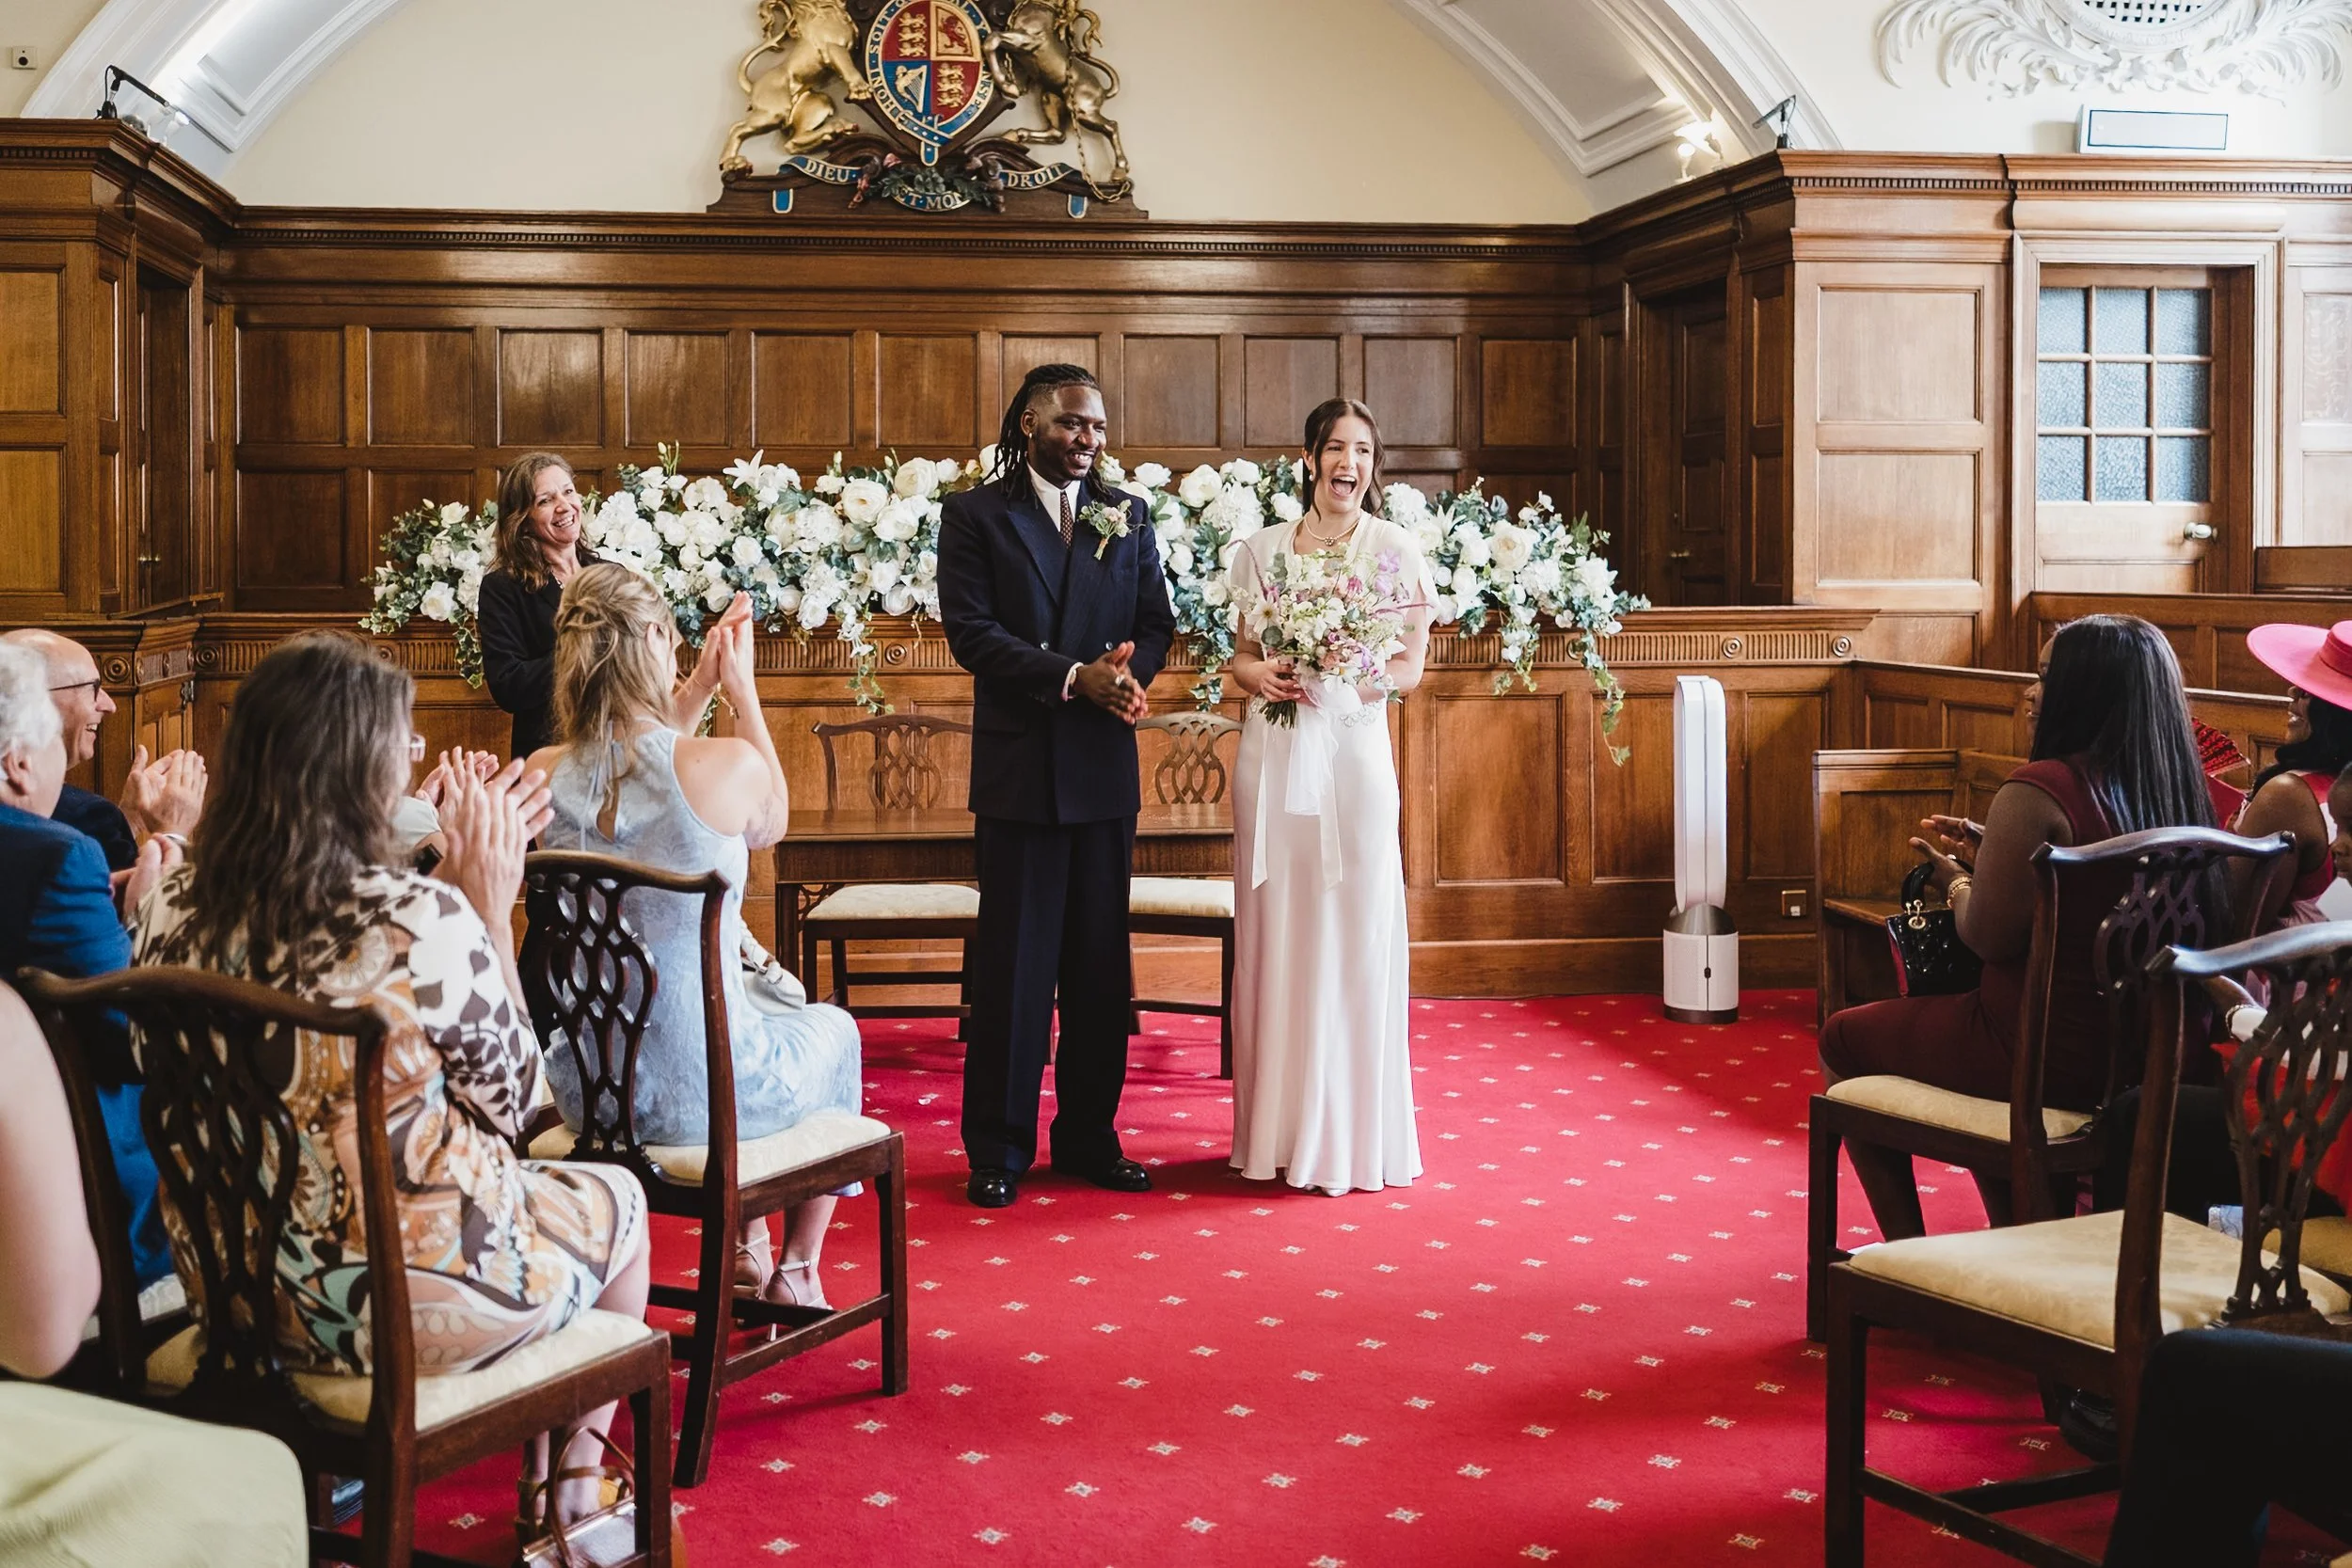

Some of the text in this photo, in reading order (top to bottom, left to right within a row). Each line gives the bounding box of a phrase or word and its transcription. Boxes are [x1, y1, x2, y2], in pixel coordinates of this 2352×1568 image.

[868, 11, 891, 54] SOIT
[870, 69, 898, 114] HONI
[804, 159, 850, 182] DIEU
[1008, 164, 1063, 187] DROIT
